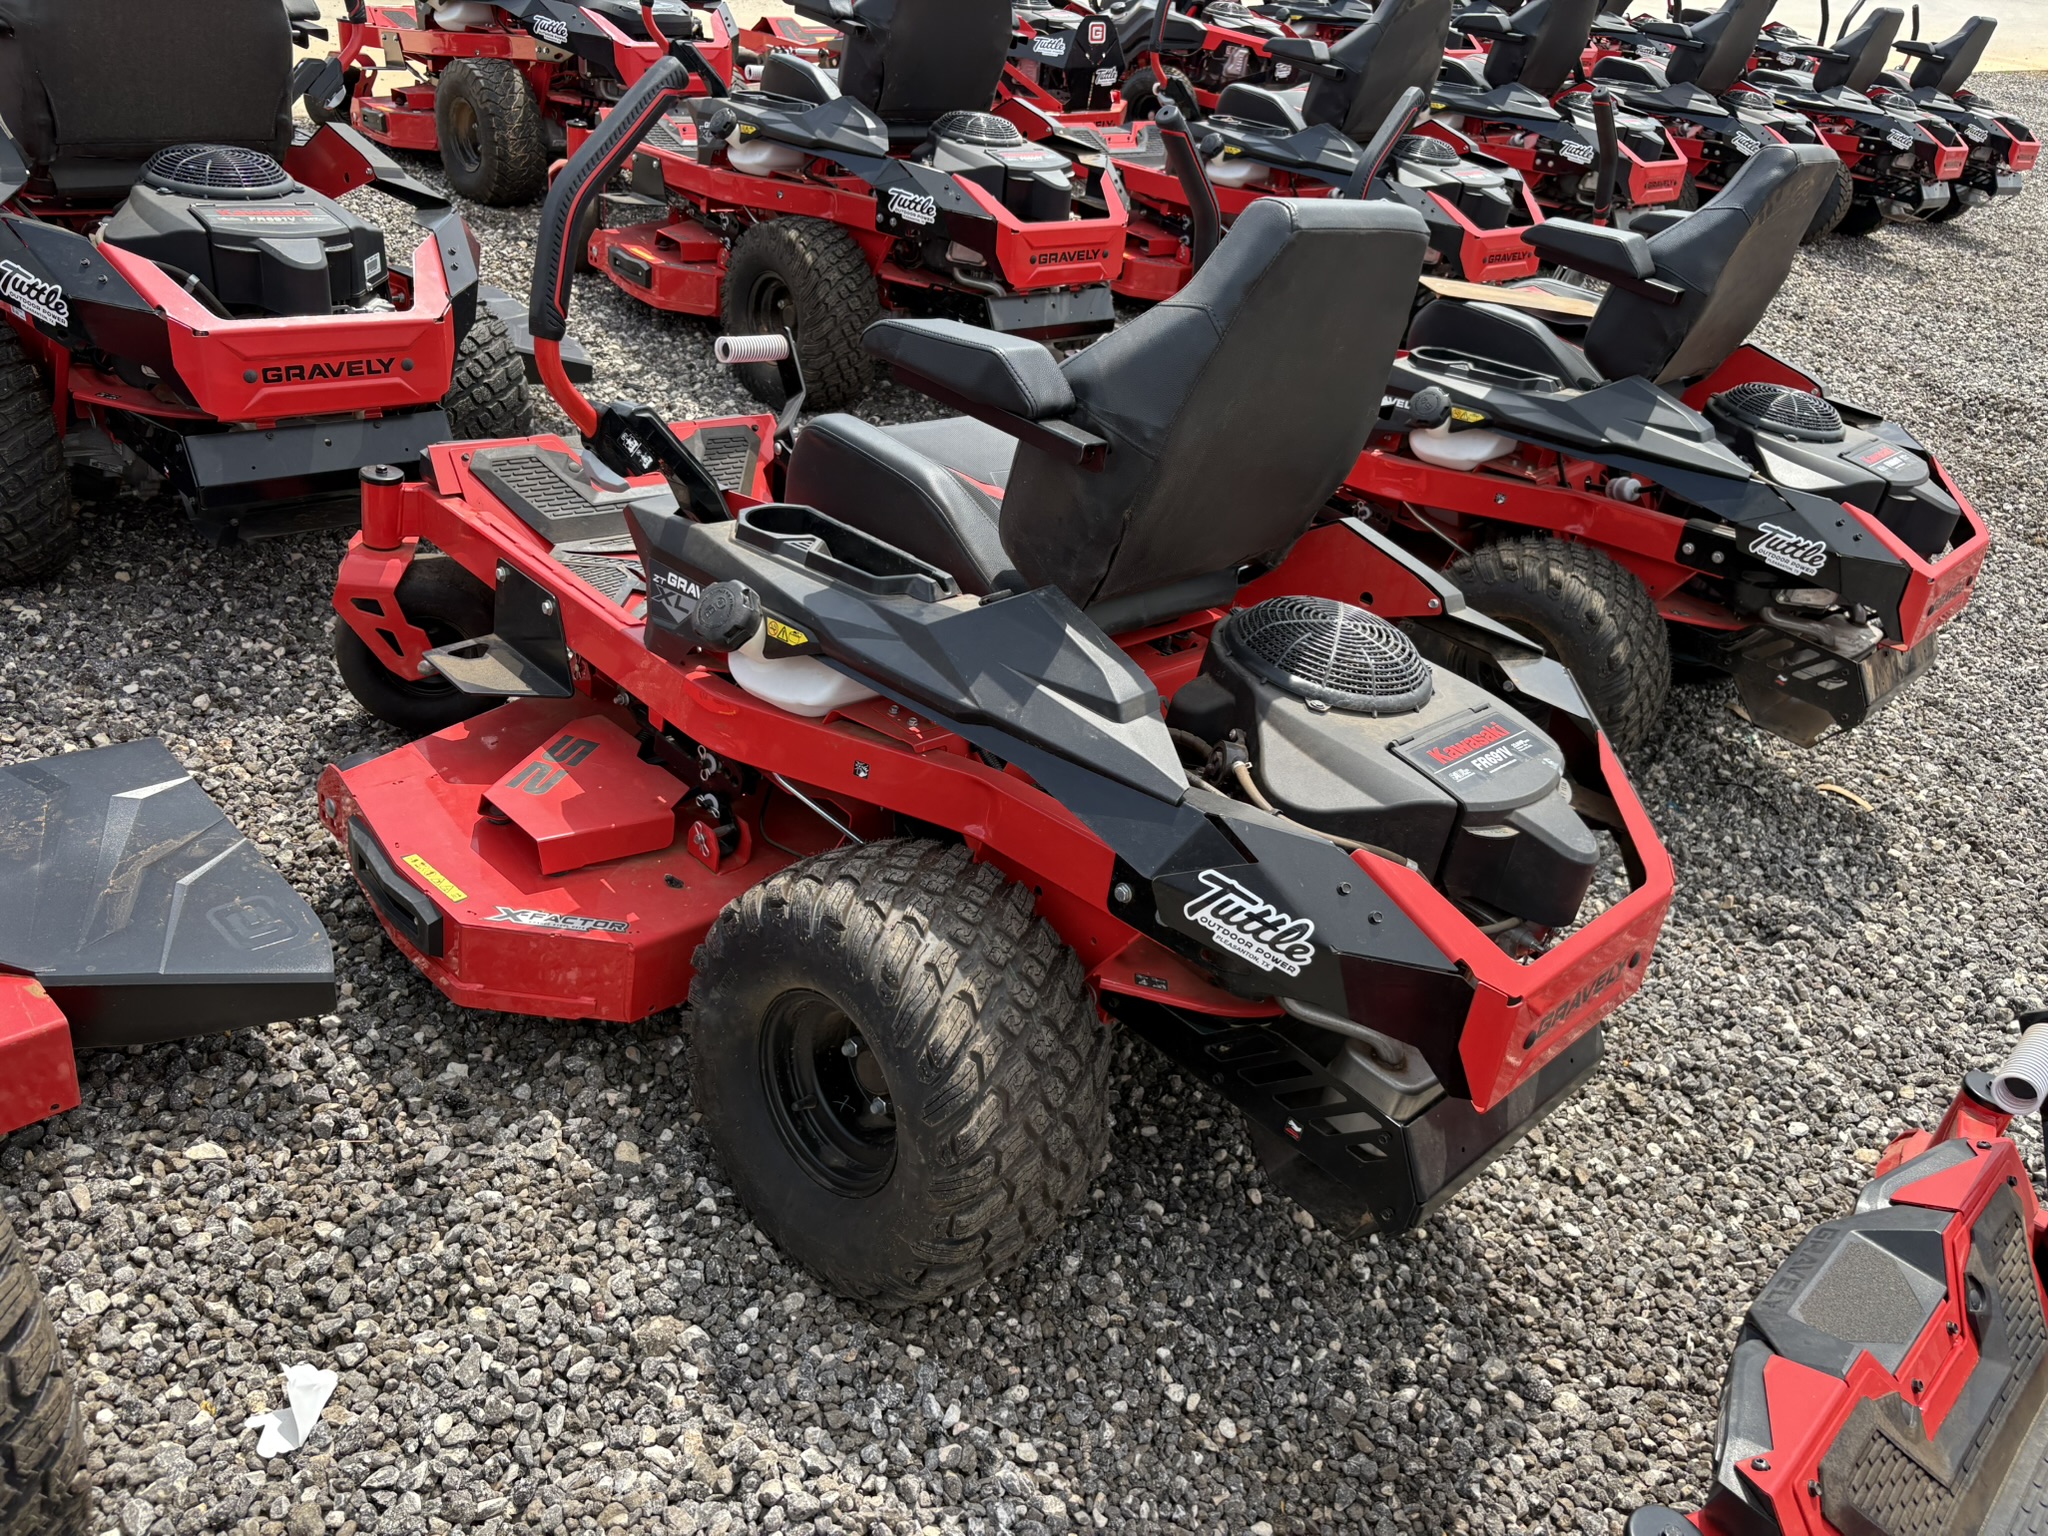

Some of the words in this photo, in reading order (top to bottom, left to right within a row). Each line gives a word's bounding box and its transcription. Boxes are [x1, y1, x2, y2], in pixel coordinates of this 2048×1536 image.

[535, 16, 567, 37] Tuttle
[1034, 37, 1065, 50] Tuttle
[1096, 67, 1117, 82] Tuttle
[1887, 129, 1913, 146] Tuttle
[1964, 124, 1988, 140] Tuttle
[1561, 140, 1594, 158] Tuttle
[889, 190, 936, 217] Tuttle
[1039, 249, 1100, 264] GRAVELY
[1488, 251, 1528, 264] GRAVELY
[1, 261, 67, 315] Tuttle
[10, 291, 41, 310] OUTDOOR
[262, 357, 396, 384] GRAVELY
[1751, 525, 1825, 567] Tuttle
[1759, 548, 1790, 564] OUTDOOR
[1791, 561, 1815, 574] POWER
[653, 574, 667, 585] ZT
[654, 585, 690, 615] XL
[1426, 721, 1511, 766] Kawasaki
[505, 734, 601, 796] 52
[1471, 745, 1514, 772] FR691V
[485, 906, 630, 931] X-FACTOR
[1187, 871, 1312, 963] Tuttle
[1200, 916, 1254, 950] OUTDOOR
[1255, 947, 1297, 974] POWER
[1215, 934, 1260, 964] PLEASANTON,
[1261, 959, 1271, 969] TX
[1536, 954, 1631, 1038] GRAVELY
[1761, 1227, 1841, 1309] GRAVELY
